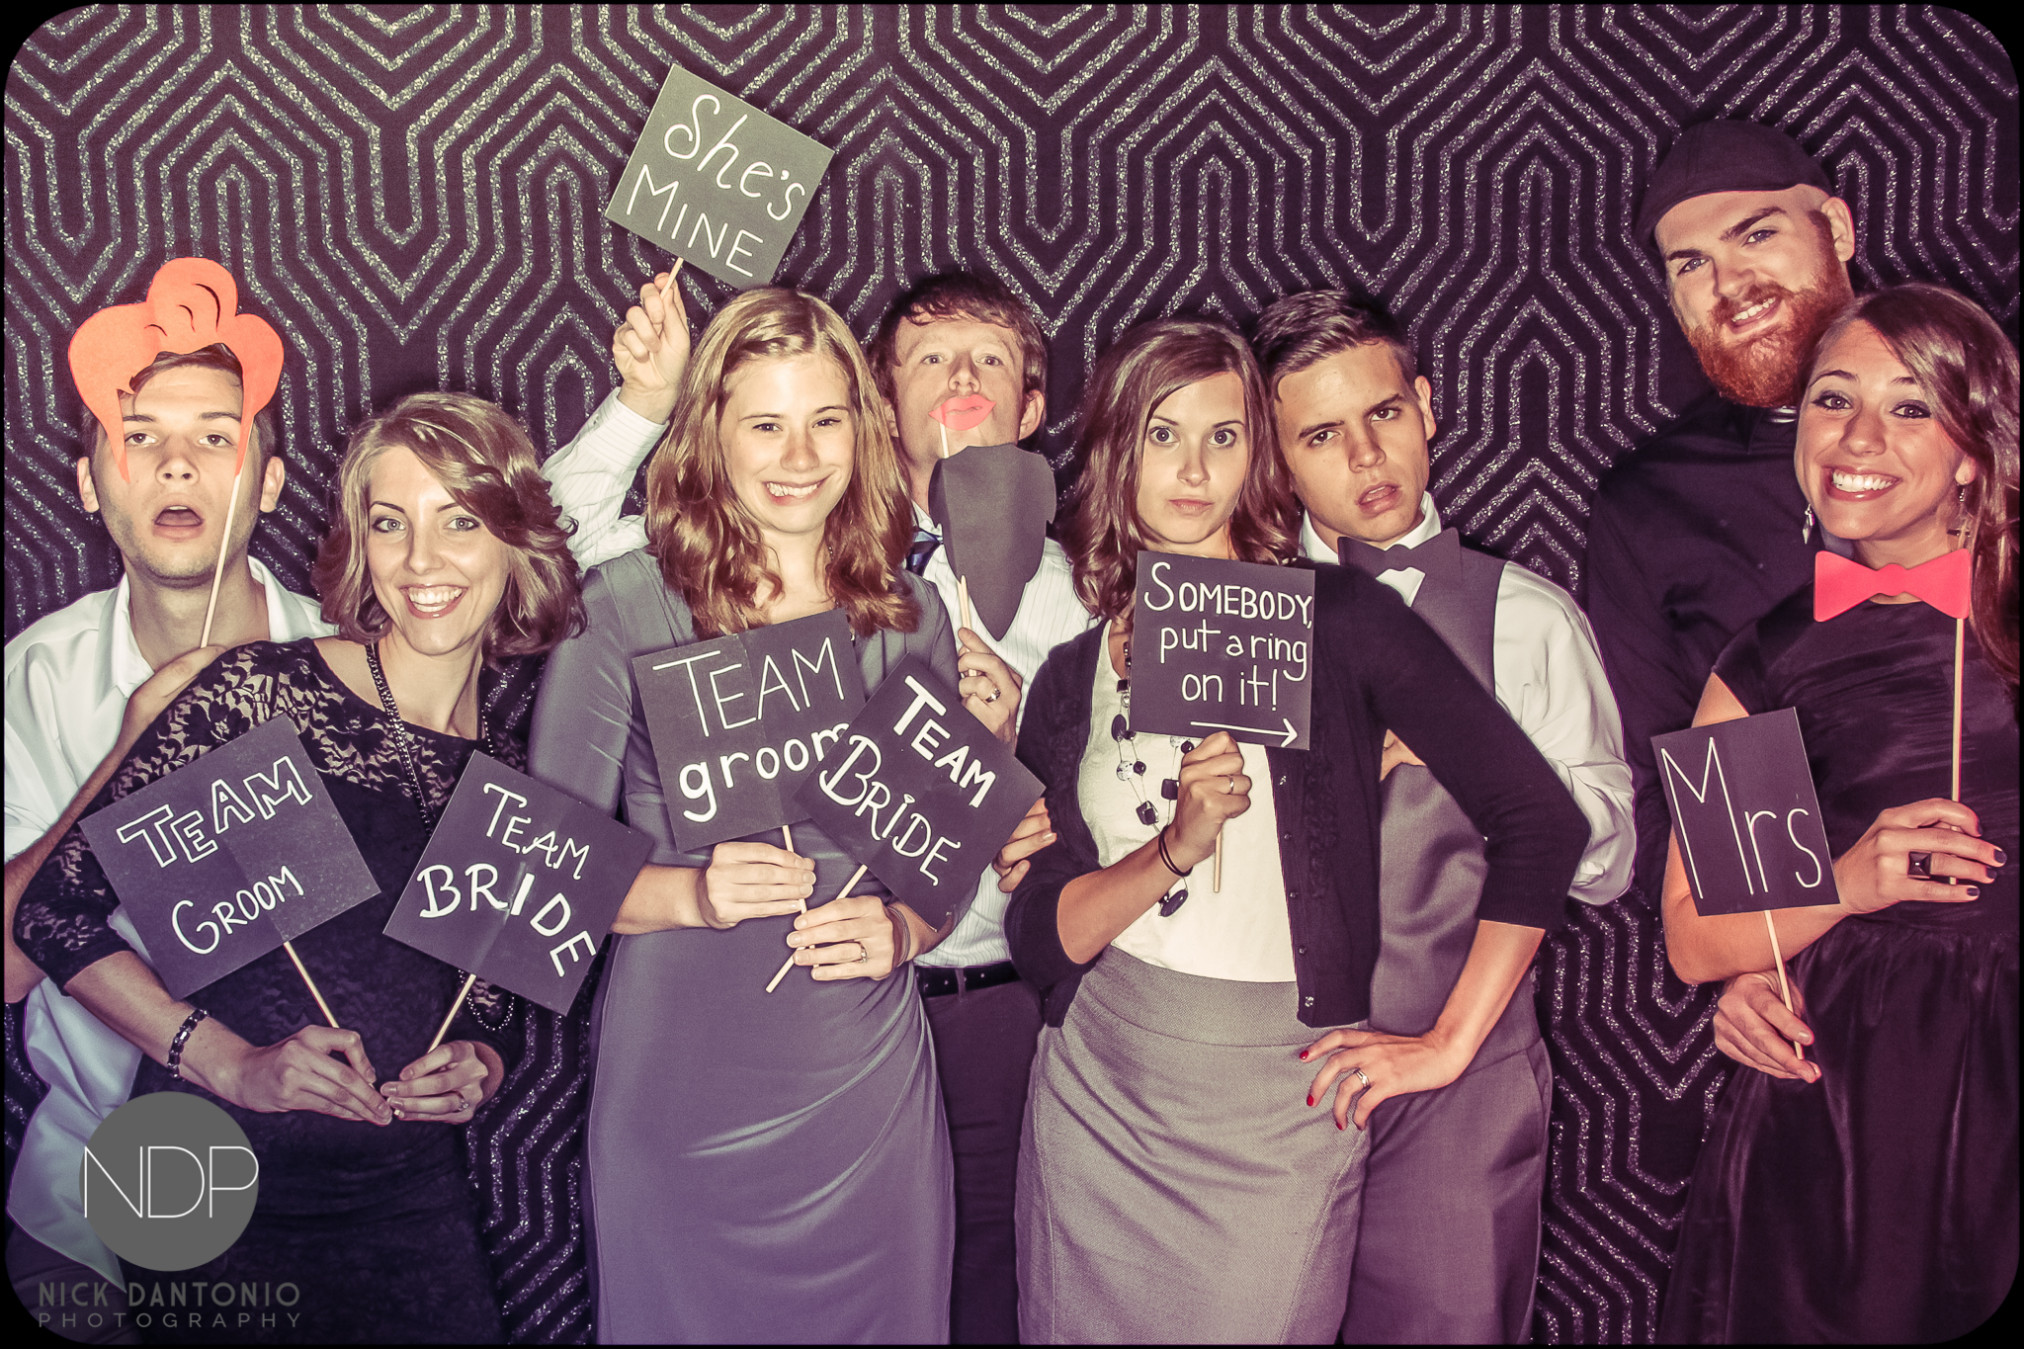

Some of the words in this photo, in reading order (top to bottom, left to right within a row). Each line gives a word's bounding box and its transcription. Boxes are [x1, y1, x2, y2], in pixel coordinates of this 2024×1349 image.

[664, 93, 806, 221] She's
[626, 163, 764, 278] MINE
[1143, 561, 1313, 629] SOMEBODY,
[1160, 618, 1221, 664] put
[1225, 635, 1244, 656] a
[1250, 633, 1308, 682] ring
[652, 636, 845, 737] TEAM
[893, 674, 997, 809] TEAM
[1181, 673, 1223, 702] on
[1240, 664, 1277, 711] it!
[116, 755, 313, 868] TEAM
[483, 782, 590, 880] TEAM
[818, 734, 962, 887] BRIDE
[1660, 736, 1822, 900] Mrs
[171, 865, 305, 955] GROOM
[416, 863, 597, 977] BRIDE
